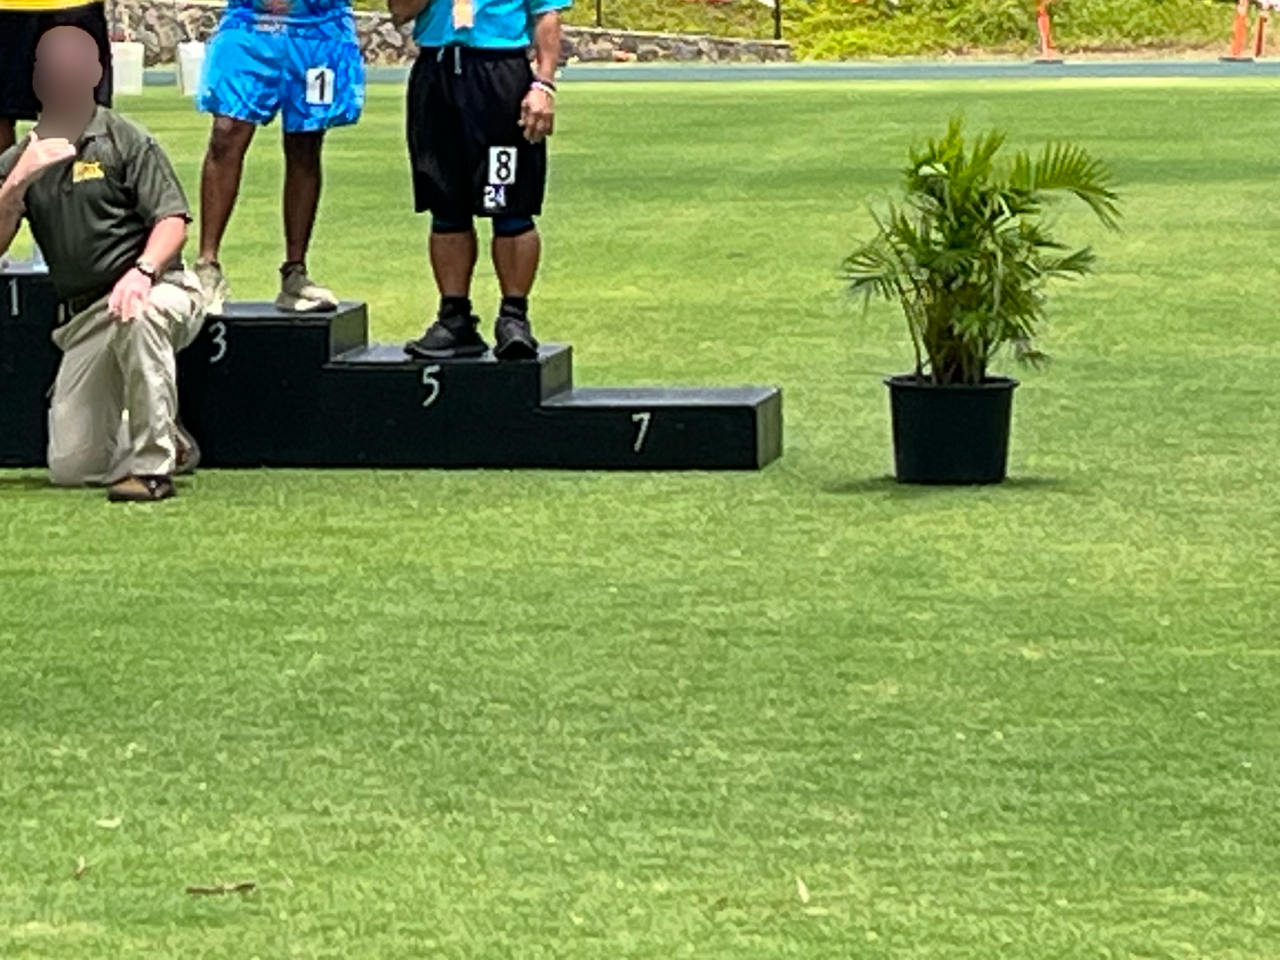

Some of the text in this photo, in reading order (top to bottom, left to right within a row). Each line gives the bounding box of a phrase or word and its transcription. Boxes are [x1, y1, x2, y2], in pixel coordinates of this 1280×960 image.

[314, 70, 326, 102] 1
[496, 150, 511, 182] 8
[483, 185, 507, 209] 24
[8, 276, 20, 316] 1
[208, 320, 227, 365] 3
[422, 364, 441, 407] 5
[631, 411, 651, 453] 7
